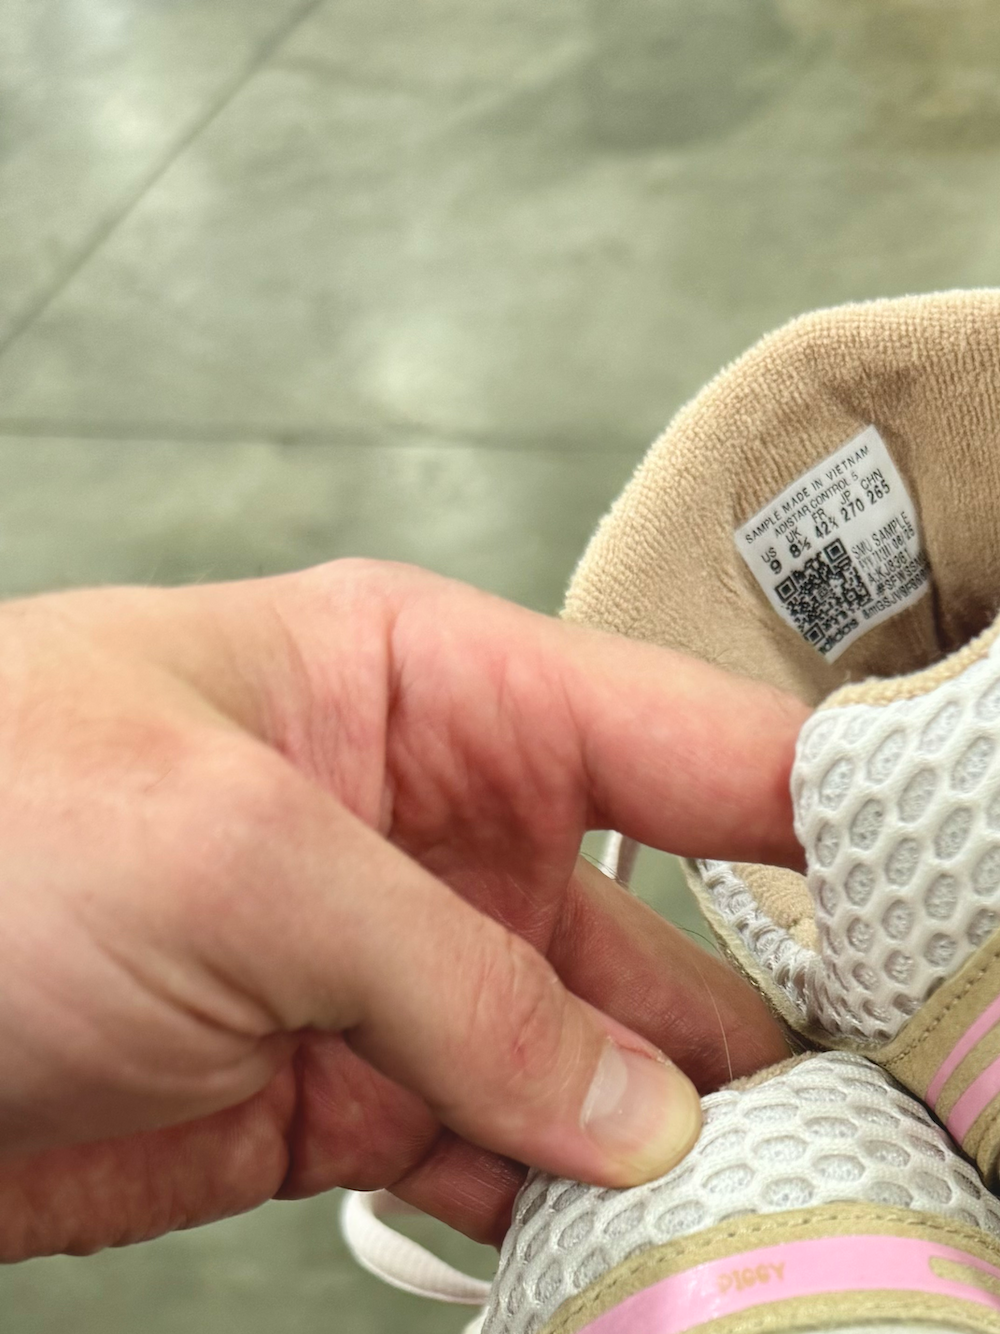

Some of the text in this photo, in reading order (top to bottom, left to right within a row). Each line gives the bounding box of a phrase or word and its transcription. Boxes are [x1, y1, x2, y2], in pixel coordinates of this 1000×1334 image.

[745, 445, 869, 544] SAMPLE MADE IN VIETNAM
[761, 468, 883, 563] US UK FR JP CHN
[770, 559, 782, 575] 9
[840, 498, 865, 522] 270
[867, 479, 890, 505] 265
[774, 471, 859, 538] ADISTAR CONTROL 5
[872, 511, 910, 547] SAMPLE
